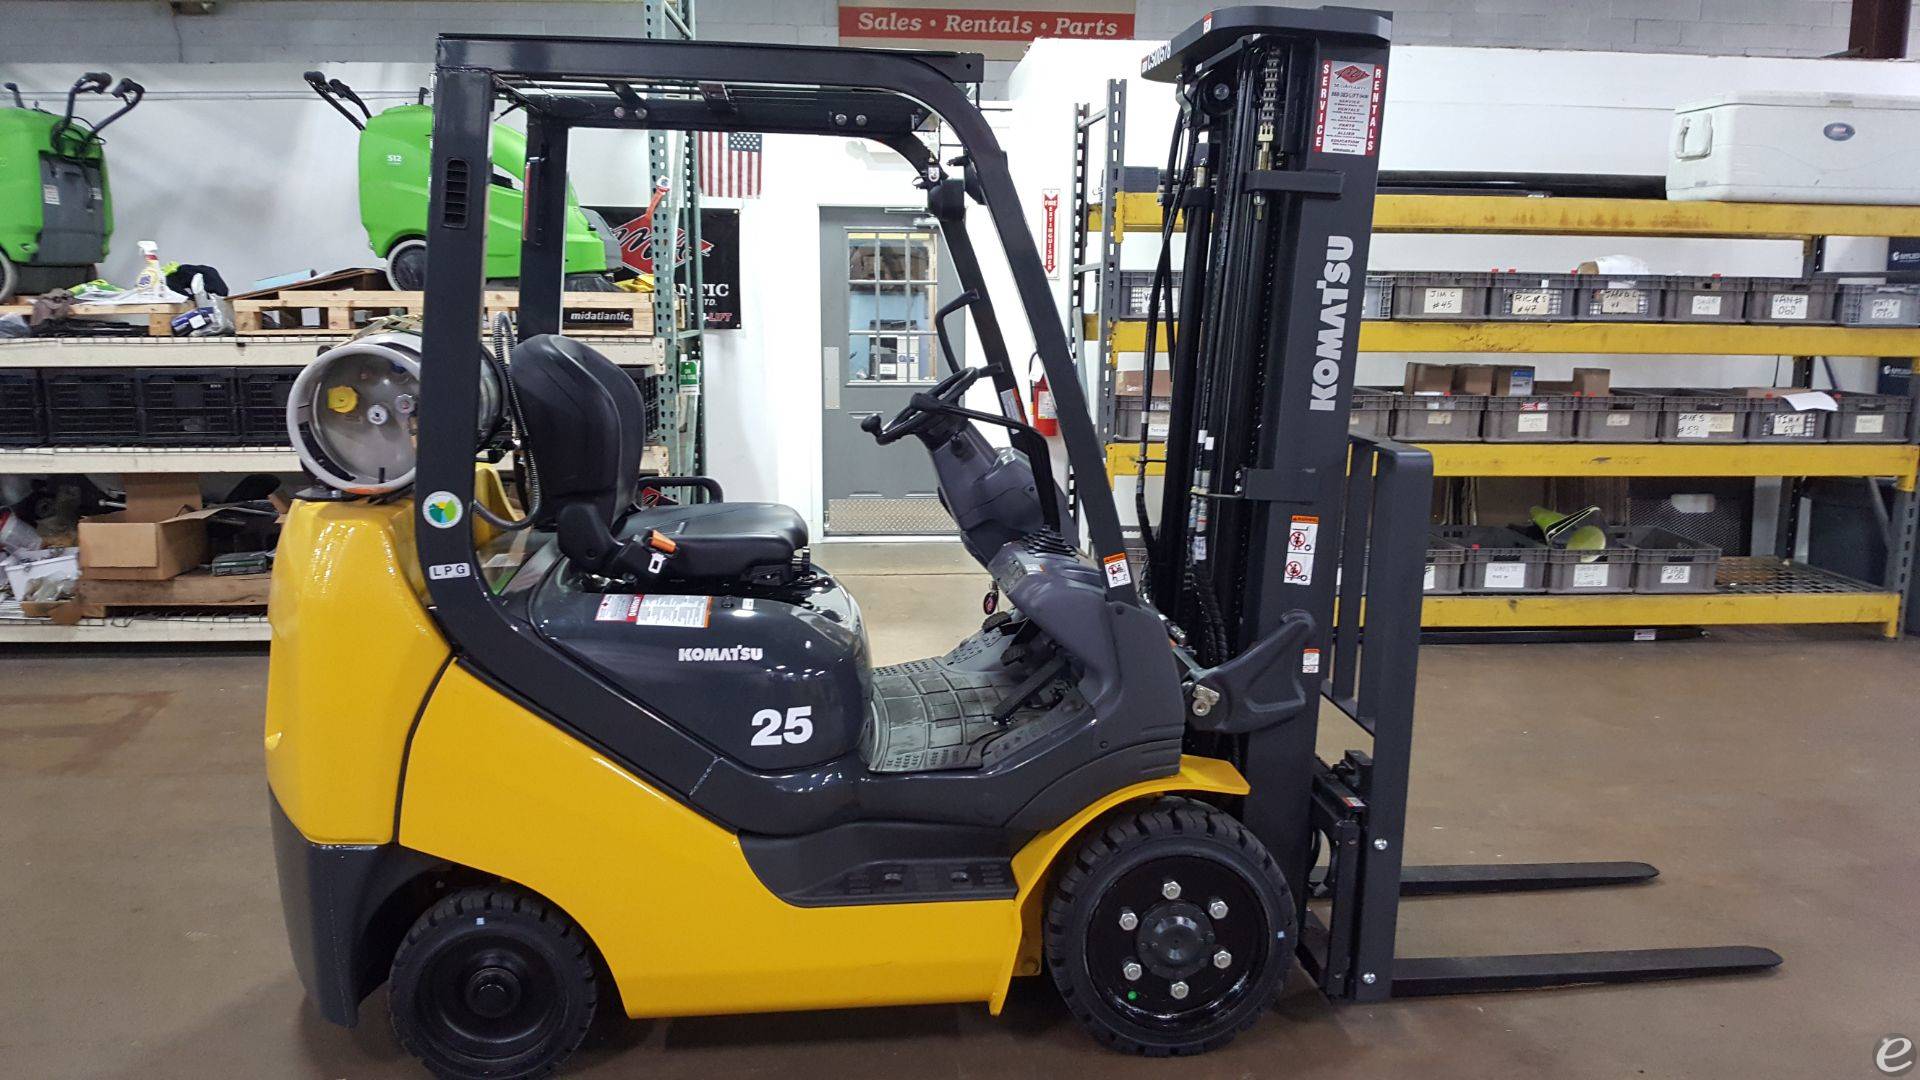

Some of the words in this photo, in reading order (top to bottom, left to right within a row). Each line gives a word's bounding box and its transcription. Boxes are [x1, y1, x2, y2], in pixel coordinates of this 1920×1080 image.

[858, 12, 922, 31] Sales
[943, 14, 1034, 35] Rentals
[1053, 17, 1119, 36] Parts
[1315, 64, 1330, 147] SERVICE
[1367, 68, 1382, 151] RENTALS
[1309, 235, 1354, 411] KOMATSU
[433, 564, 466, 577] LPG
[678, 645, 763, 662] KOMATSU
[750, 705, 814, 747] 25
